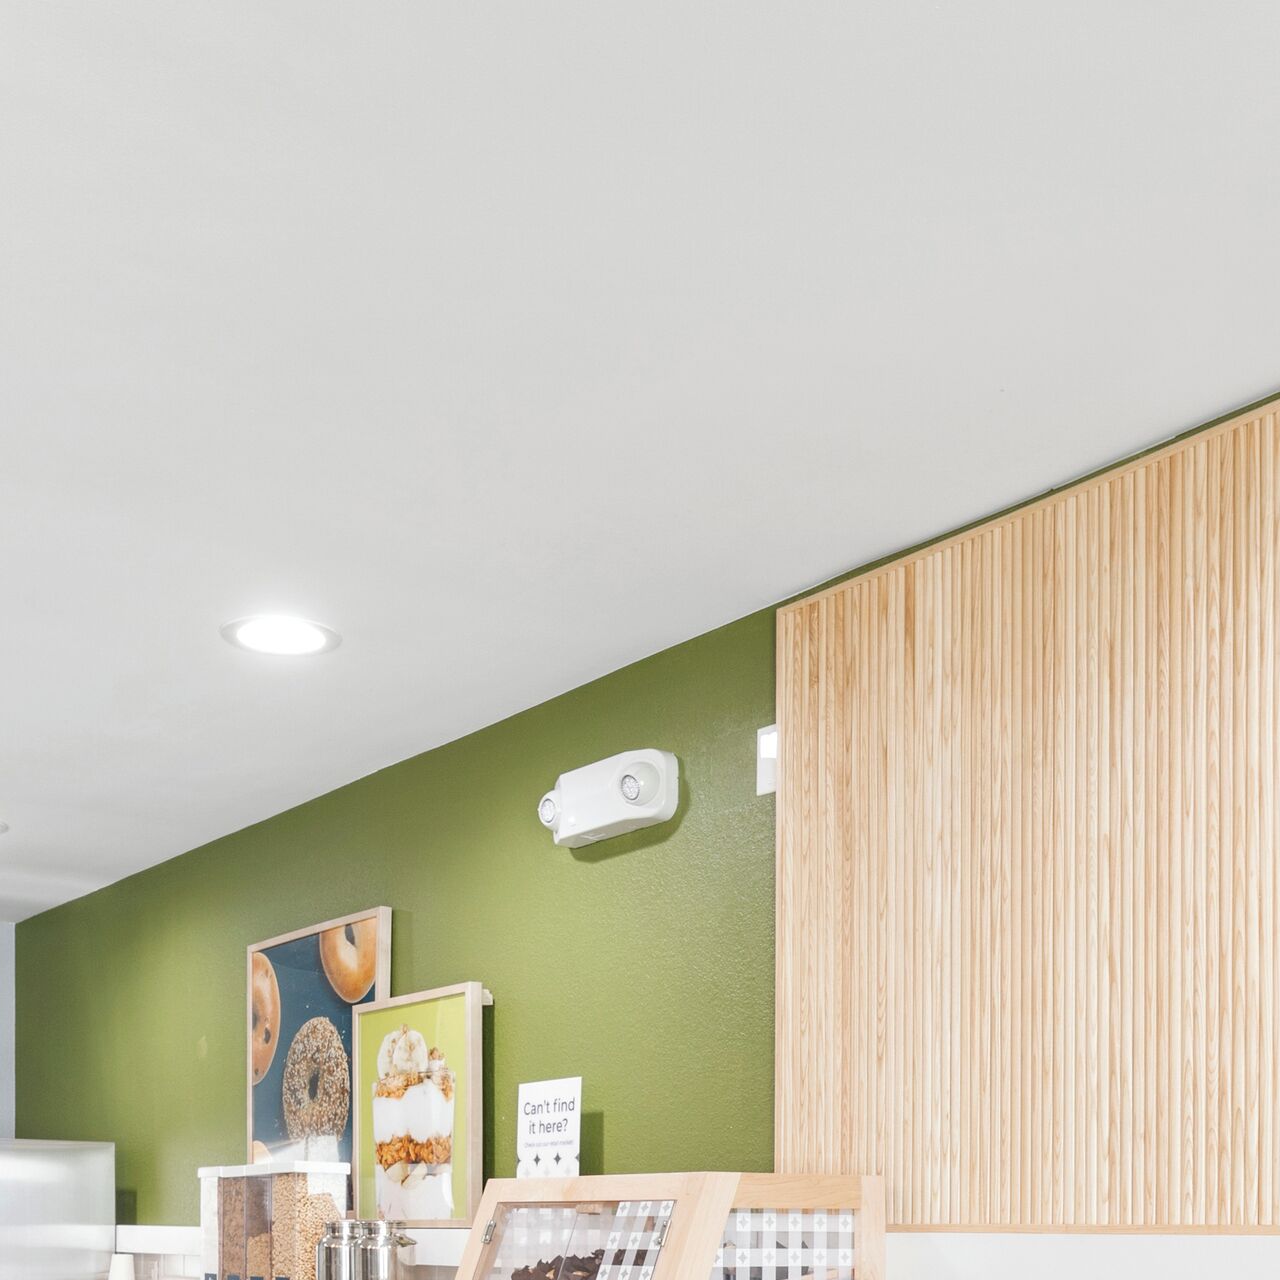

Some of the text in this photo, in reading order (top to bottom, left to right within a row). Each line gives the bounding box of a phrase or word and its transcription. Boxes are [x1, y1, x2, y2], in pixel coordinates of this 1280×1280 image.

[523, 1096, 576, 1116] Can't find
[528, 1118, 569, 1134] it here?
